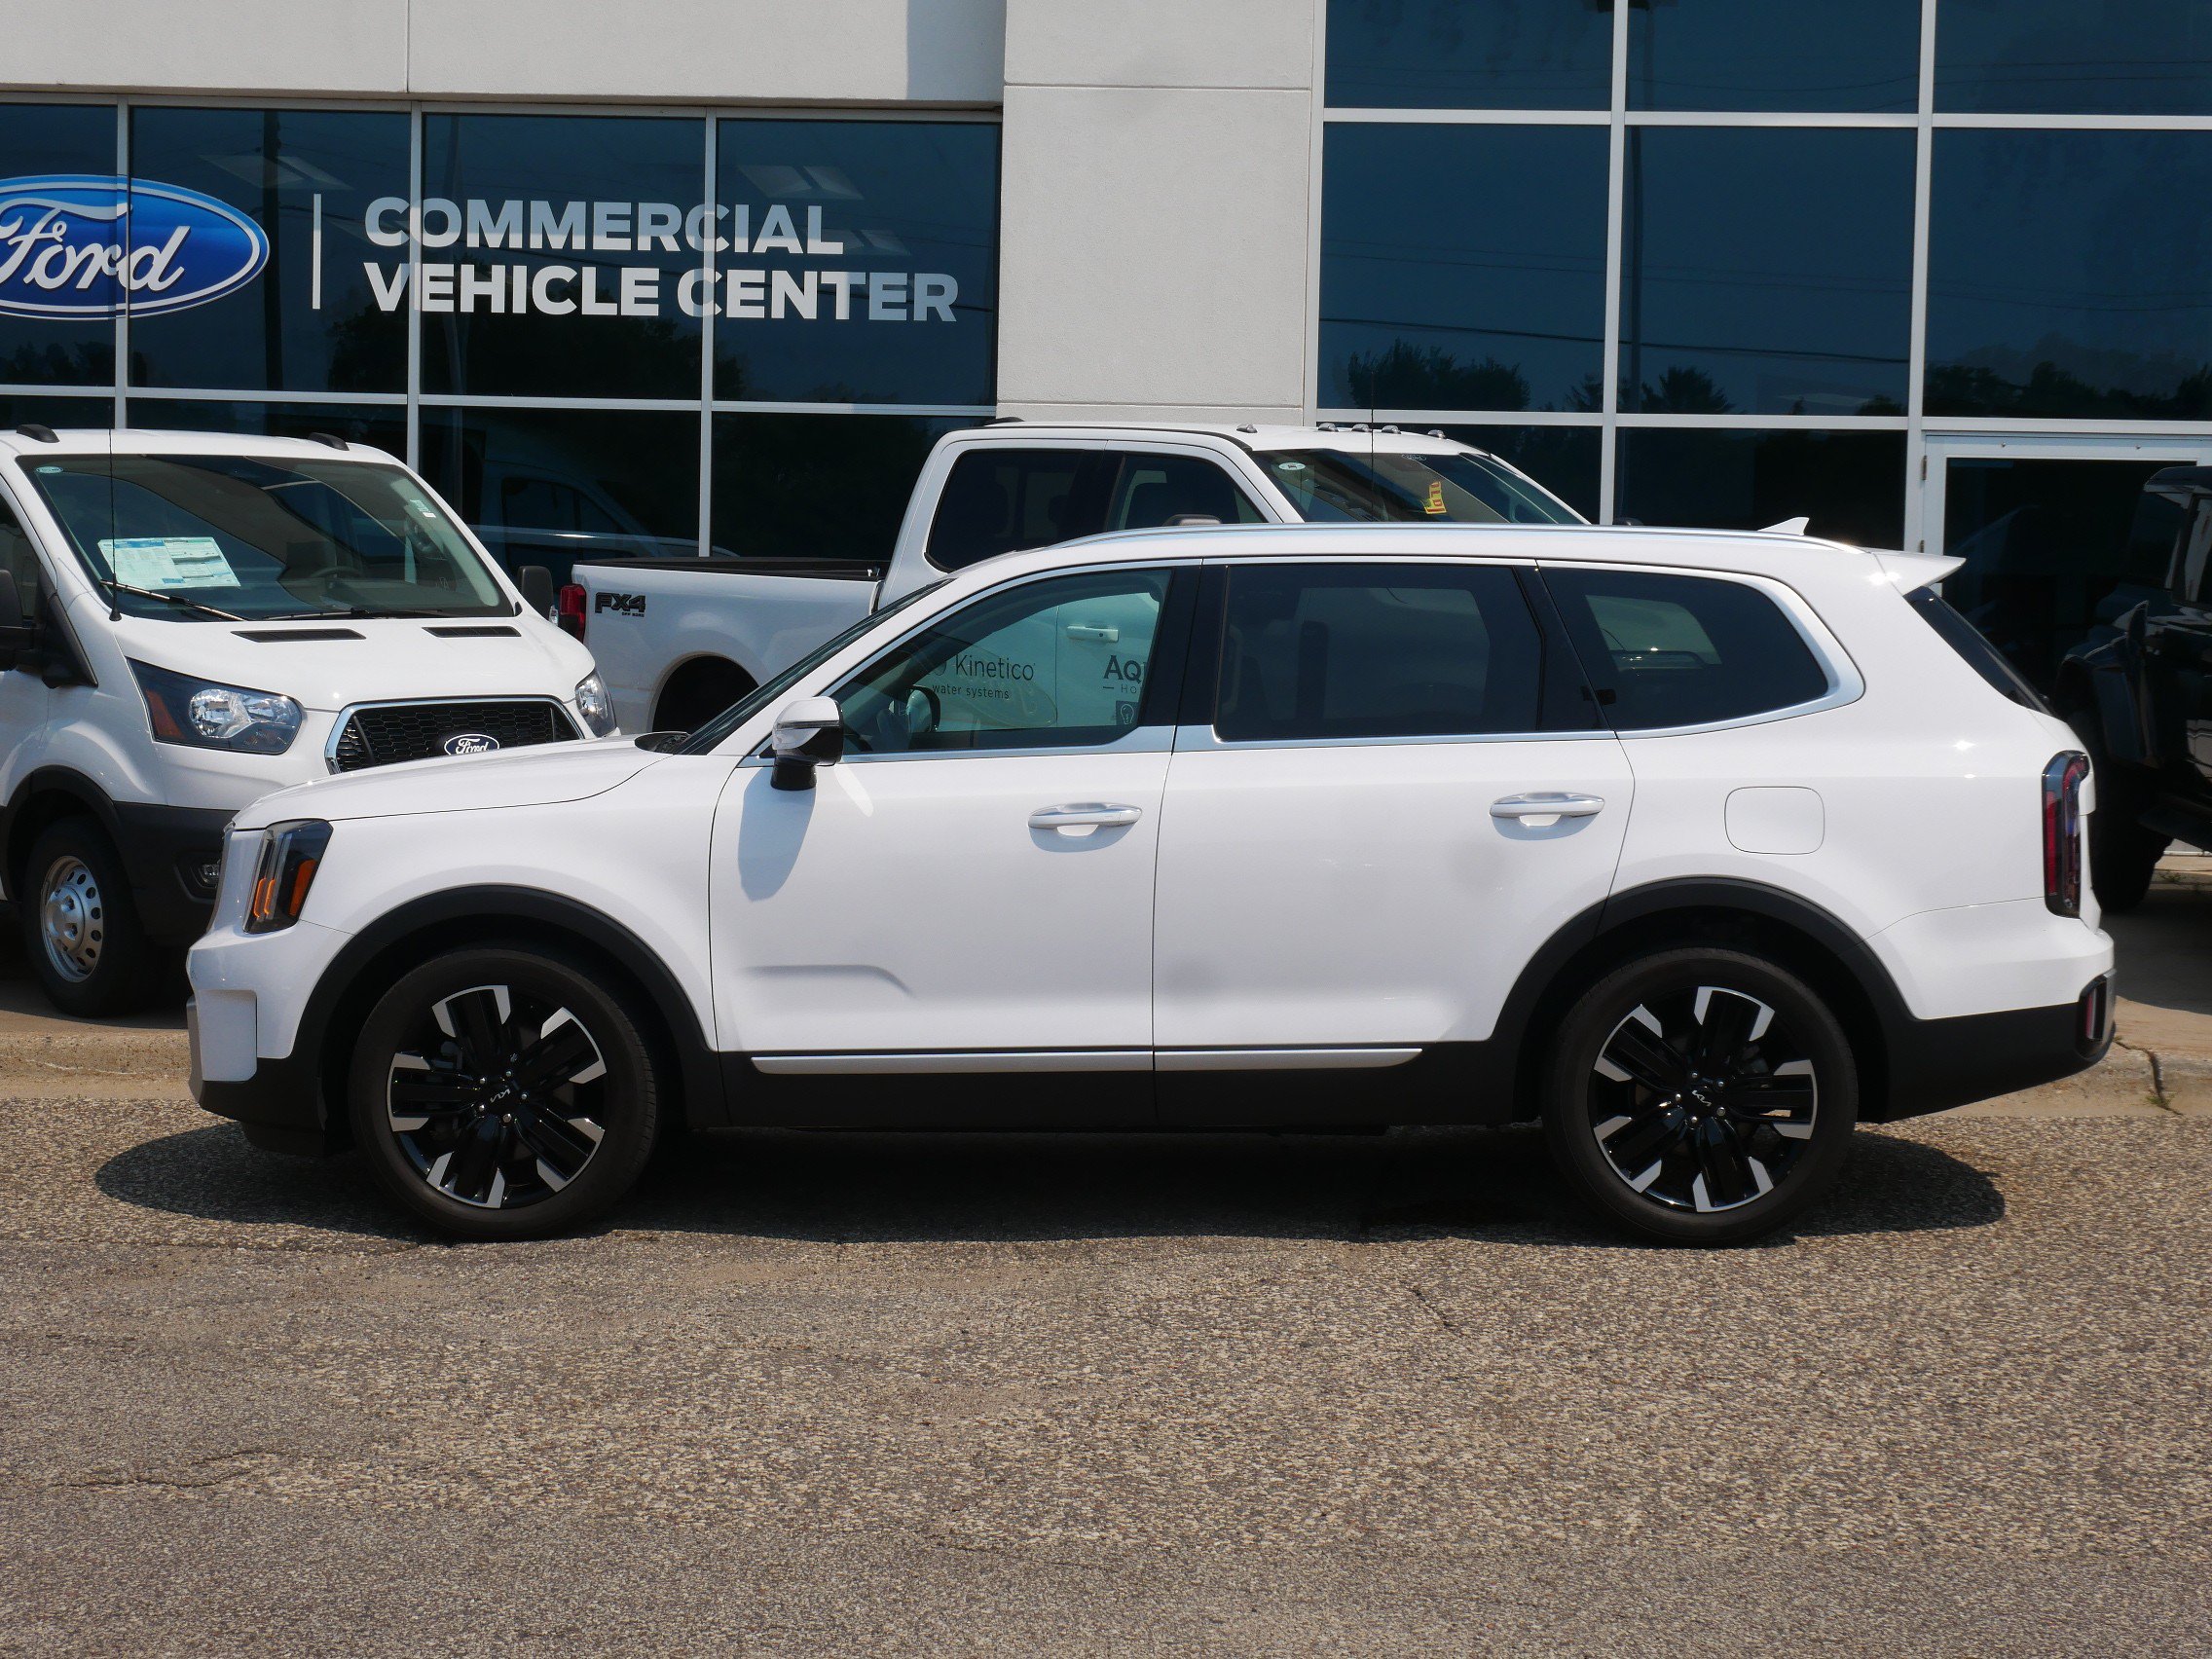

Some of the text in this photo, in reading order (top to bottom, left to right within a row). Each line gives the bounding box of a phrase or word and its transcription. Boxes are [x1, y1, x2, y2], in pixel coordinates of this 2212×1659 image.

[365, 197, 844, 255] COMMERCIAL
[0, 198, 191, 292] Ford
[363, 262, 959, 322] VEHICLE CENTER
[595, 592, 646, 613] FX4
[955, 655, 1034, 681] Kinetico
[933, 684, 1010, 699] water systems
[455, 737, 490, 755] Ford
